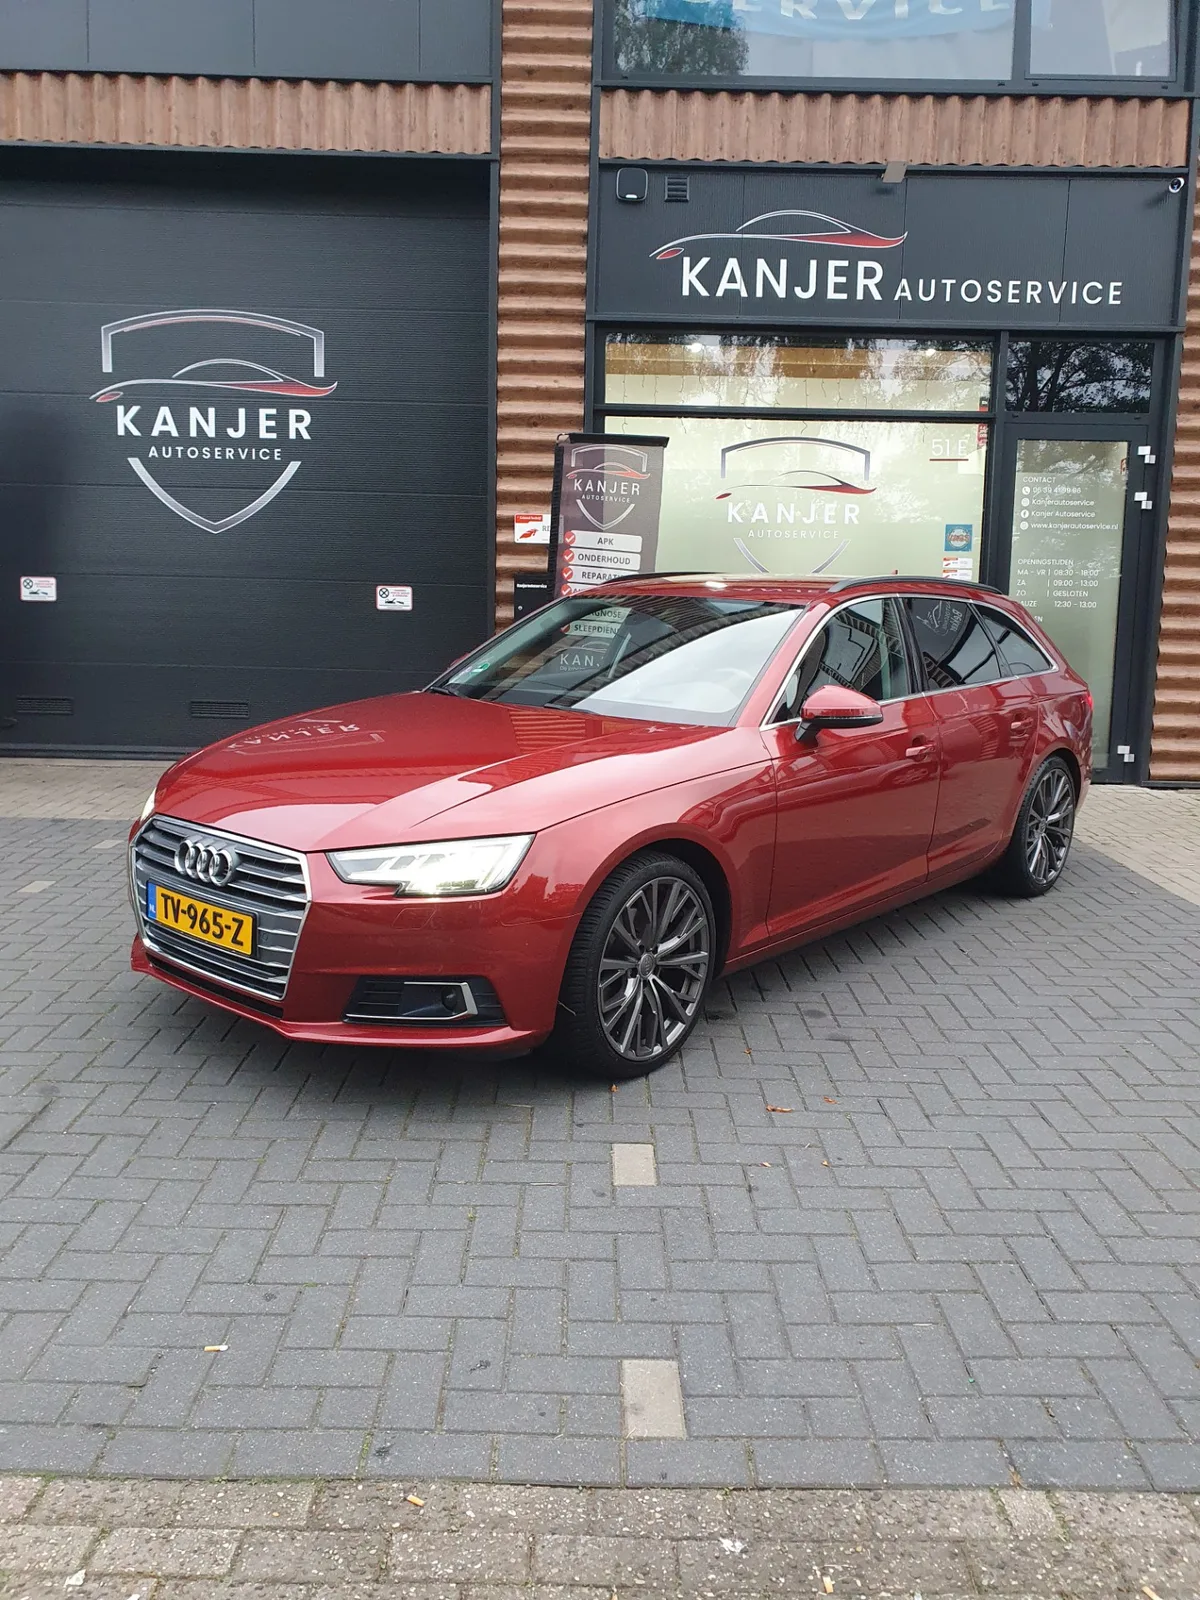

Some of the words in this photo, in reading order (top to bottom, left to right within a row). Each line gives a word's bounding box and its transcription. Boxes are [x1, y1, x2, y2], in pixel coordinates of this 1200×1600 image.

[681, 255, 885, 301] KANJER
[894, 278, 1123, 305] AUTOSERVICE
[116, 404, 312, 440] KANJER
[148, 445, 282, 461] AUTOSERVICE
[931, 439, 950, 456] 51
[574, 479, 640, 495] KANJER
[582, 494, 630, 503] AUTOSERVICE
[727, 502, 860, 525] KANJER
[1031, 510, 1053, 519] Kanjer
[1055, 510, 1096, 518] Autoservice
[1031, 522, 1118, 530] www.kanjerautoservice.nl
[748, 529, 839, 539] AUTOSERVICE
[597, 537, 614, 545] APK
[577, 553, 631, 565] ONDERHOUD
[1017, 558, 1074, 566] OPENINGSTIJDEN
[1053, 579, 1074, 587] 09:00
[1054, 600, 1072, 608] 12:30
[160, 893, 244, 947] TV-965-Z
